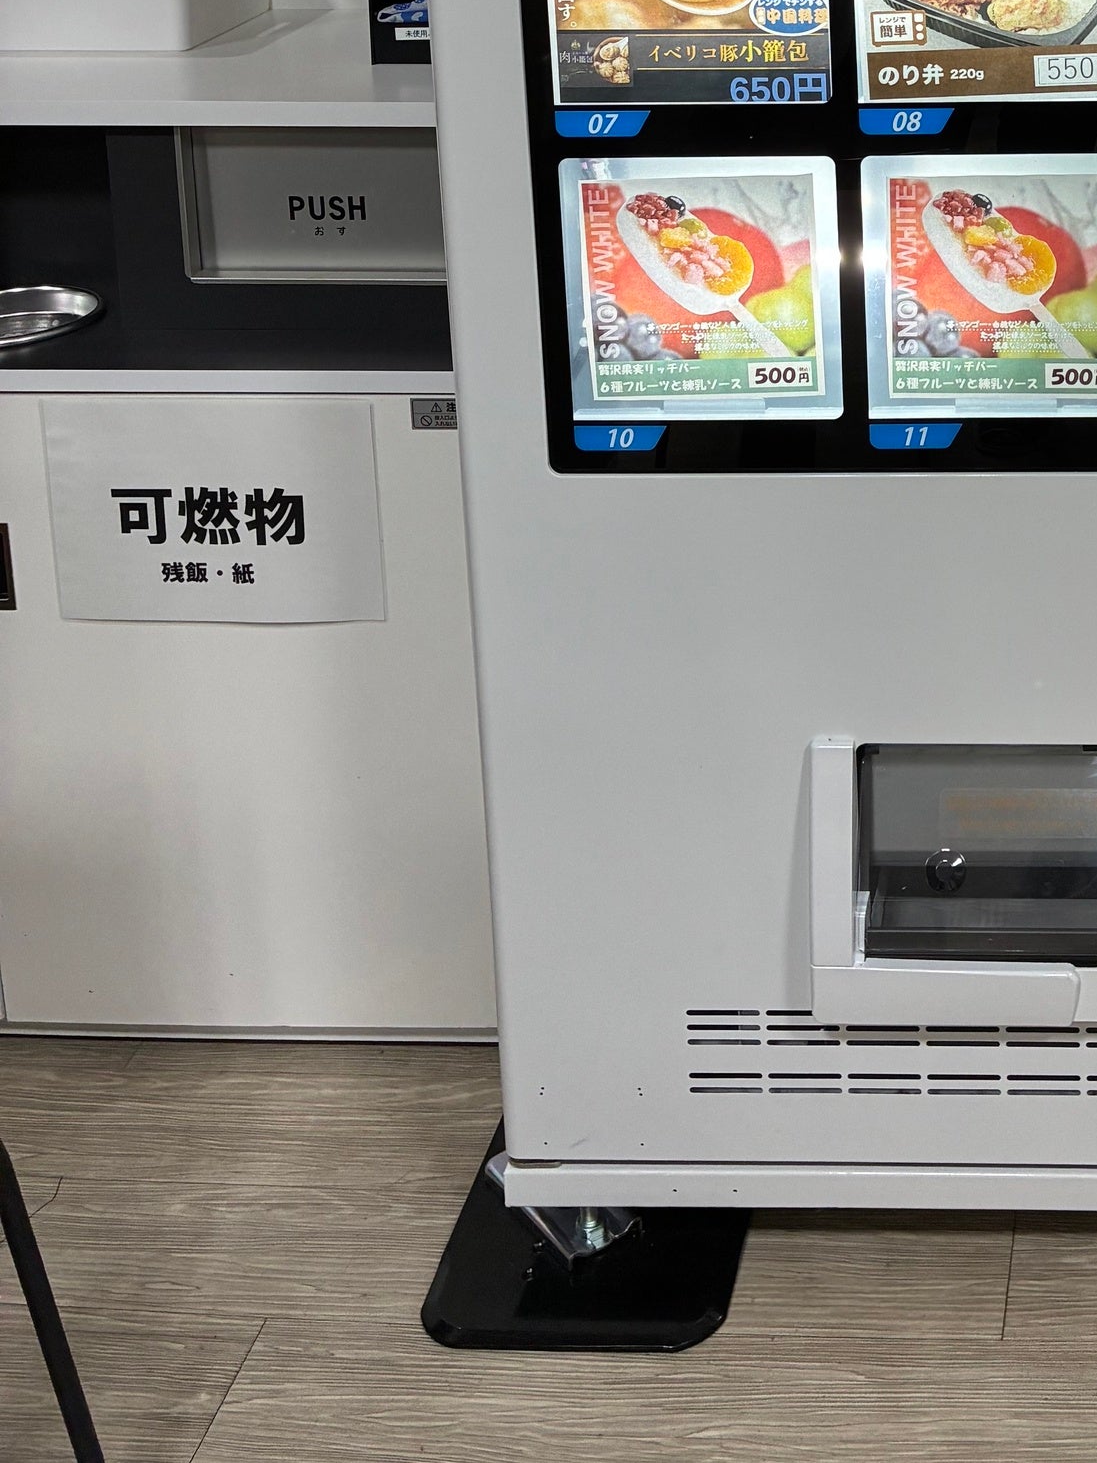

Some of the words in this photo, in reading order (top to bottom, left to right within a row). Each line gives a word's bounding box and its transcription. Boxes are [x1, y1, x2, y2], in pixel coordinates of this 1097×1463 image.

[879, 16, 906, 24] レンジで
[405, 30, 430, 38] 未使用
[880, 25, 907, 38] 簡単
[649, 39, 809, 63] イベリコ豚小籠包
[878, 65, 944, 85] のり弁
[950, 68, 984, 81] 220g
[1048, 57, 1094, 80] 550
[730, 73, 827, 102] 650円
[588, 113, 619, 134] 07
[892, 112, 922, 132] 08
[288, 195, 367, 221] PUSH
[588, 188, 617, 278] WHITE
[895, 184, 917, 268] WHITE
[596, 280, 618, 359] SNOW
[896, 279, 918, 355] SNOW
[755, 367, 795, 384] 500
[798, 372, 810, 384] 円
[1051, 368, 1092, 386] 500
[608, 428, 634, 448] 10
[904, 427, 929, 446] 11
[110, 487, 306, 545] 可燃物
[161, 561, 255, 584] 残飯・紙
